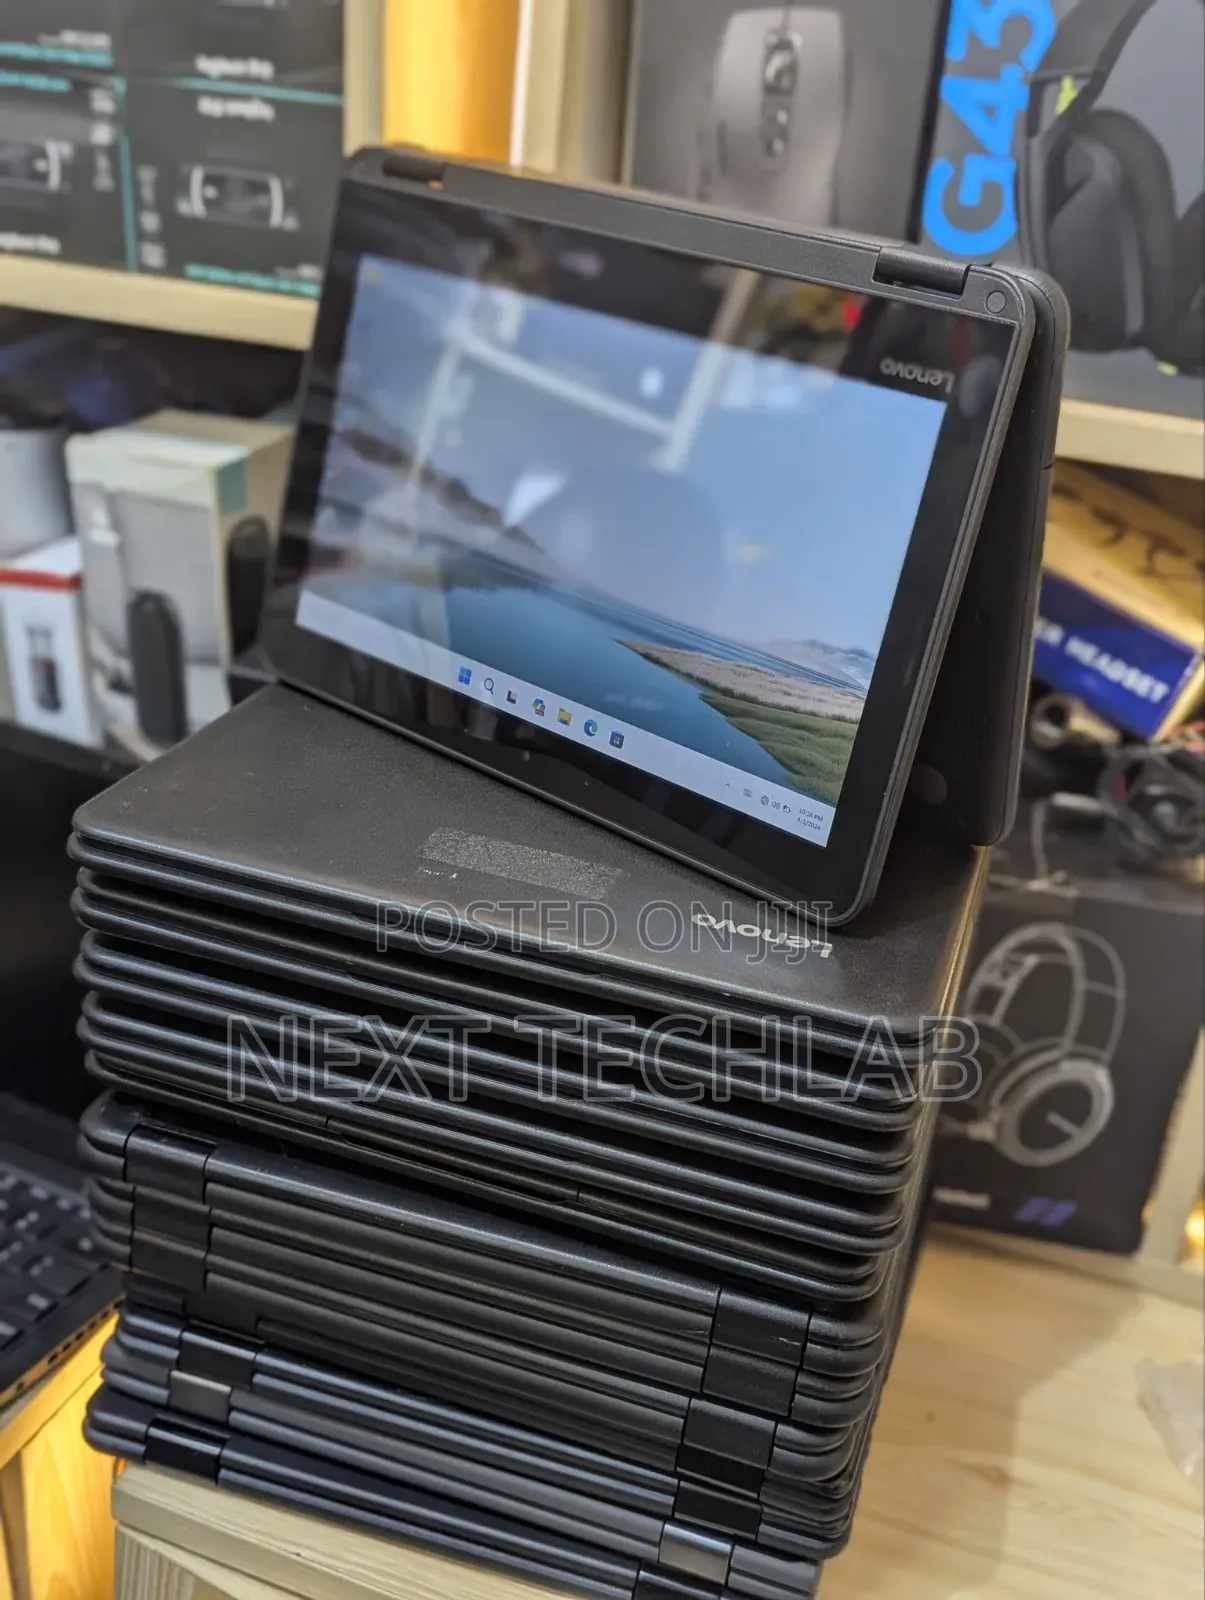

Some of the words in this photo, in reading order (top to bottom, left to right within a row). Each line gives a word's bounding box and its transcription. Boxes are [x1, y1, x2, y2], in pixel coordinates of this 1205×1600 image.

[880, 357, 955, 394] Lenovo
[1064, 636, 1169, 704] HEADSET
[813, 814, 823, 822] PM
[691, 913, 833, 959] Lenovo
